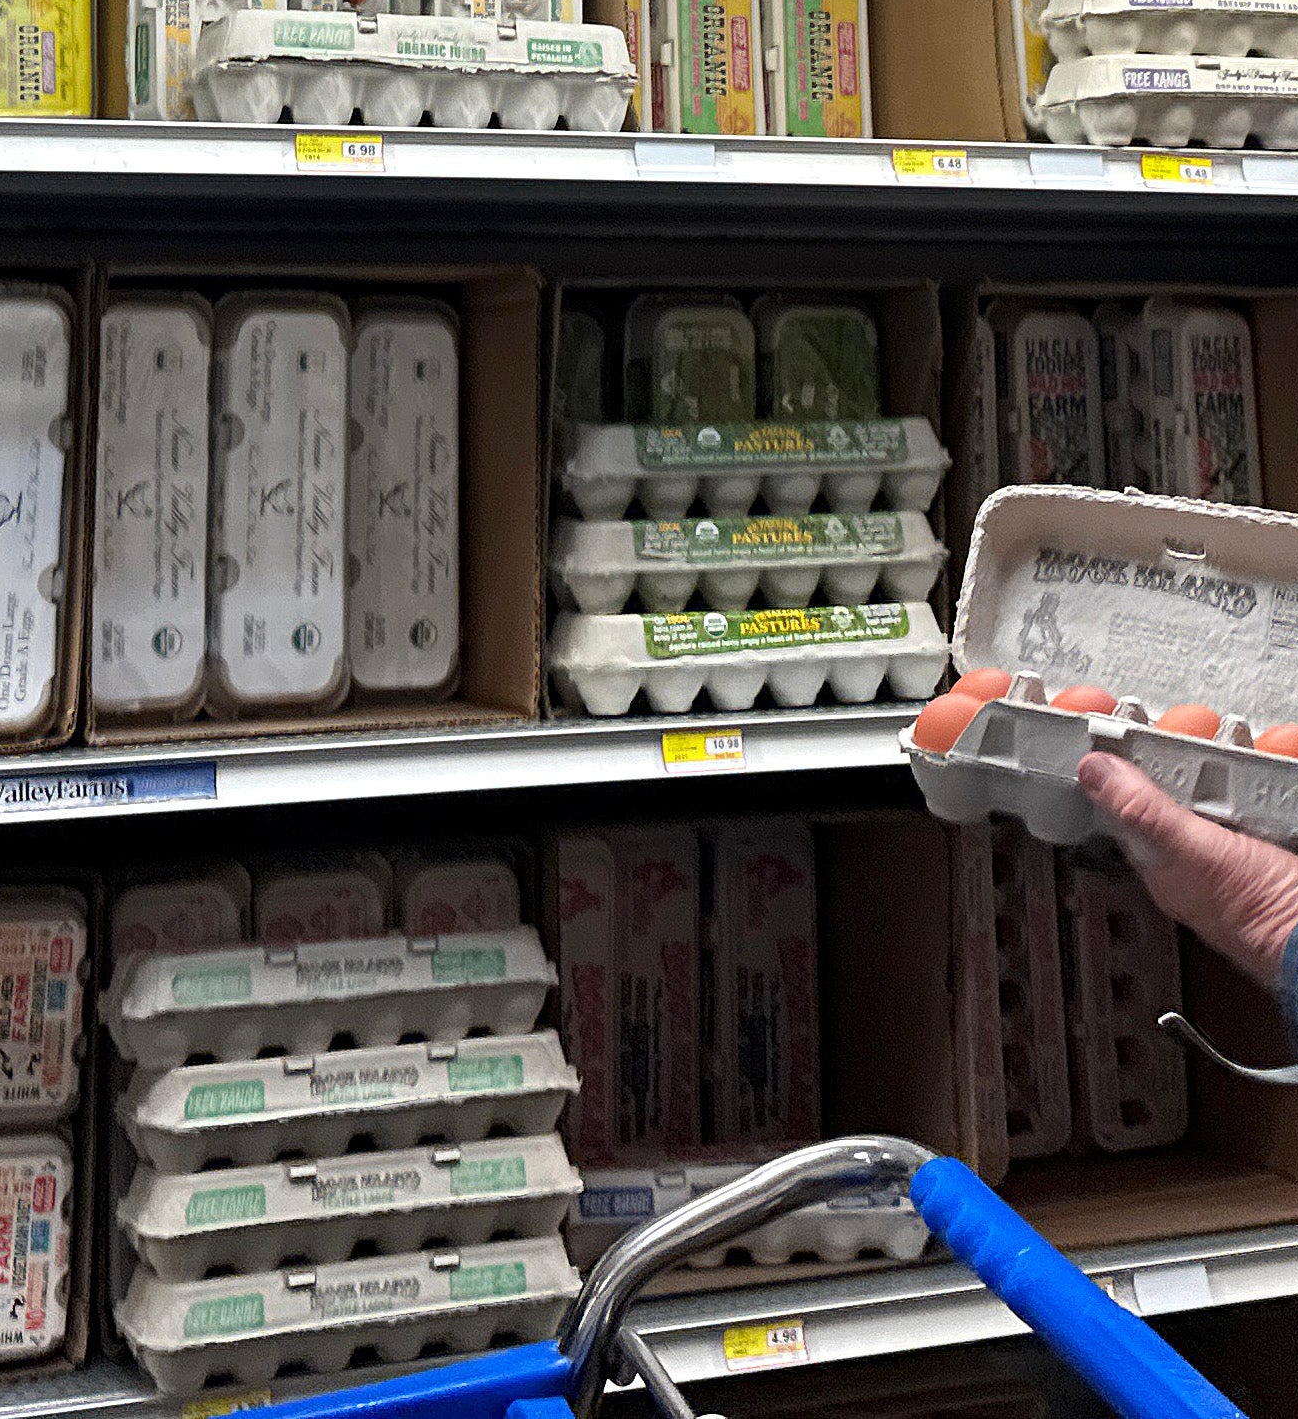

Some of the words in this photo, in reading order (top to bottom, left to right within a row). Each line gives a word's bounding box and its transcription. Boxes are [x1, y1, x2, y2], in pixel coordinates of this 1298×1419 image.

[275, 21, 306, 43] FREE
[310, 23, 353, 47] RANGE
[397, 42, 447, 58] ORGANIC
[703, 5, 726, 96] ORGANIC
[809, 11, 833, 101] ORGANIC
[1124, 71, 1152, 88] FREE
[1154, 70, 1189, 89] RANGE
[348, 144, 376, 157] 6.98
[1028, 392, 1088, 417] FARM
[734, 439, 815, 453] PASTURES
[732, 531, 814, 546] PASTURES
[740, 616, 821, 636] PASTURES
[12, 660, 25, 702] Grade
